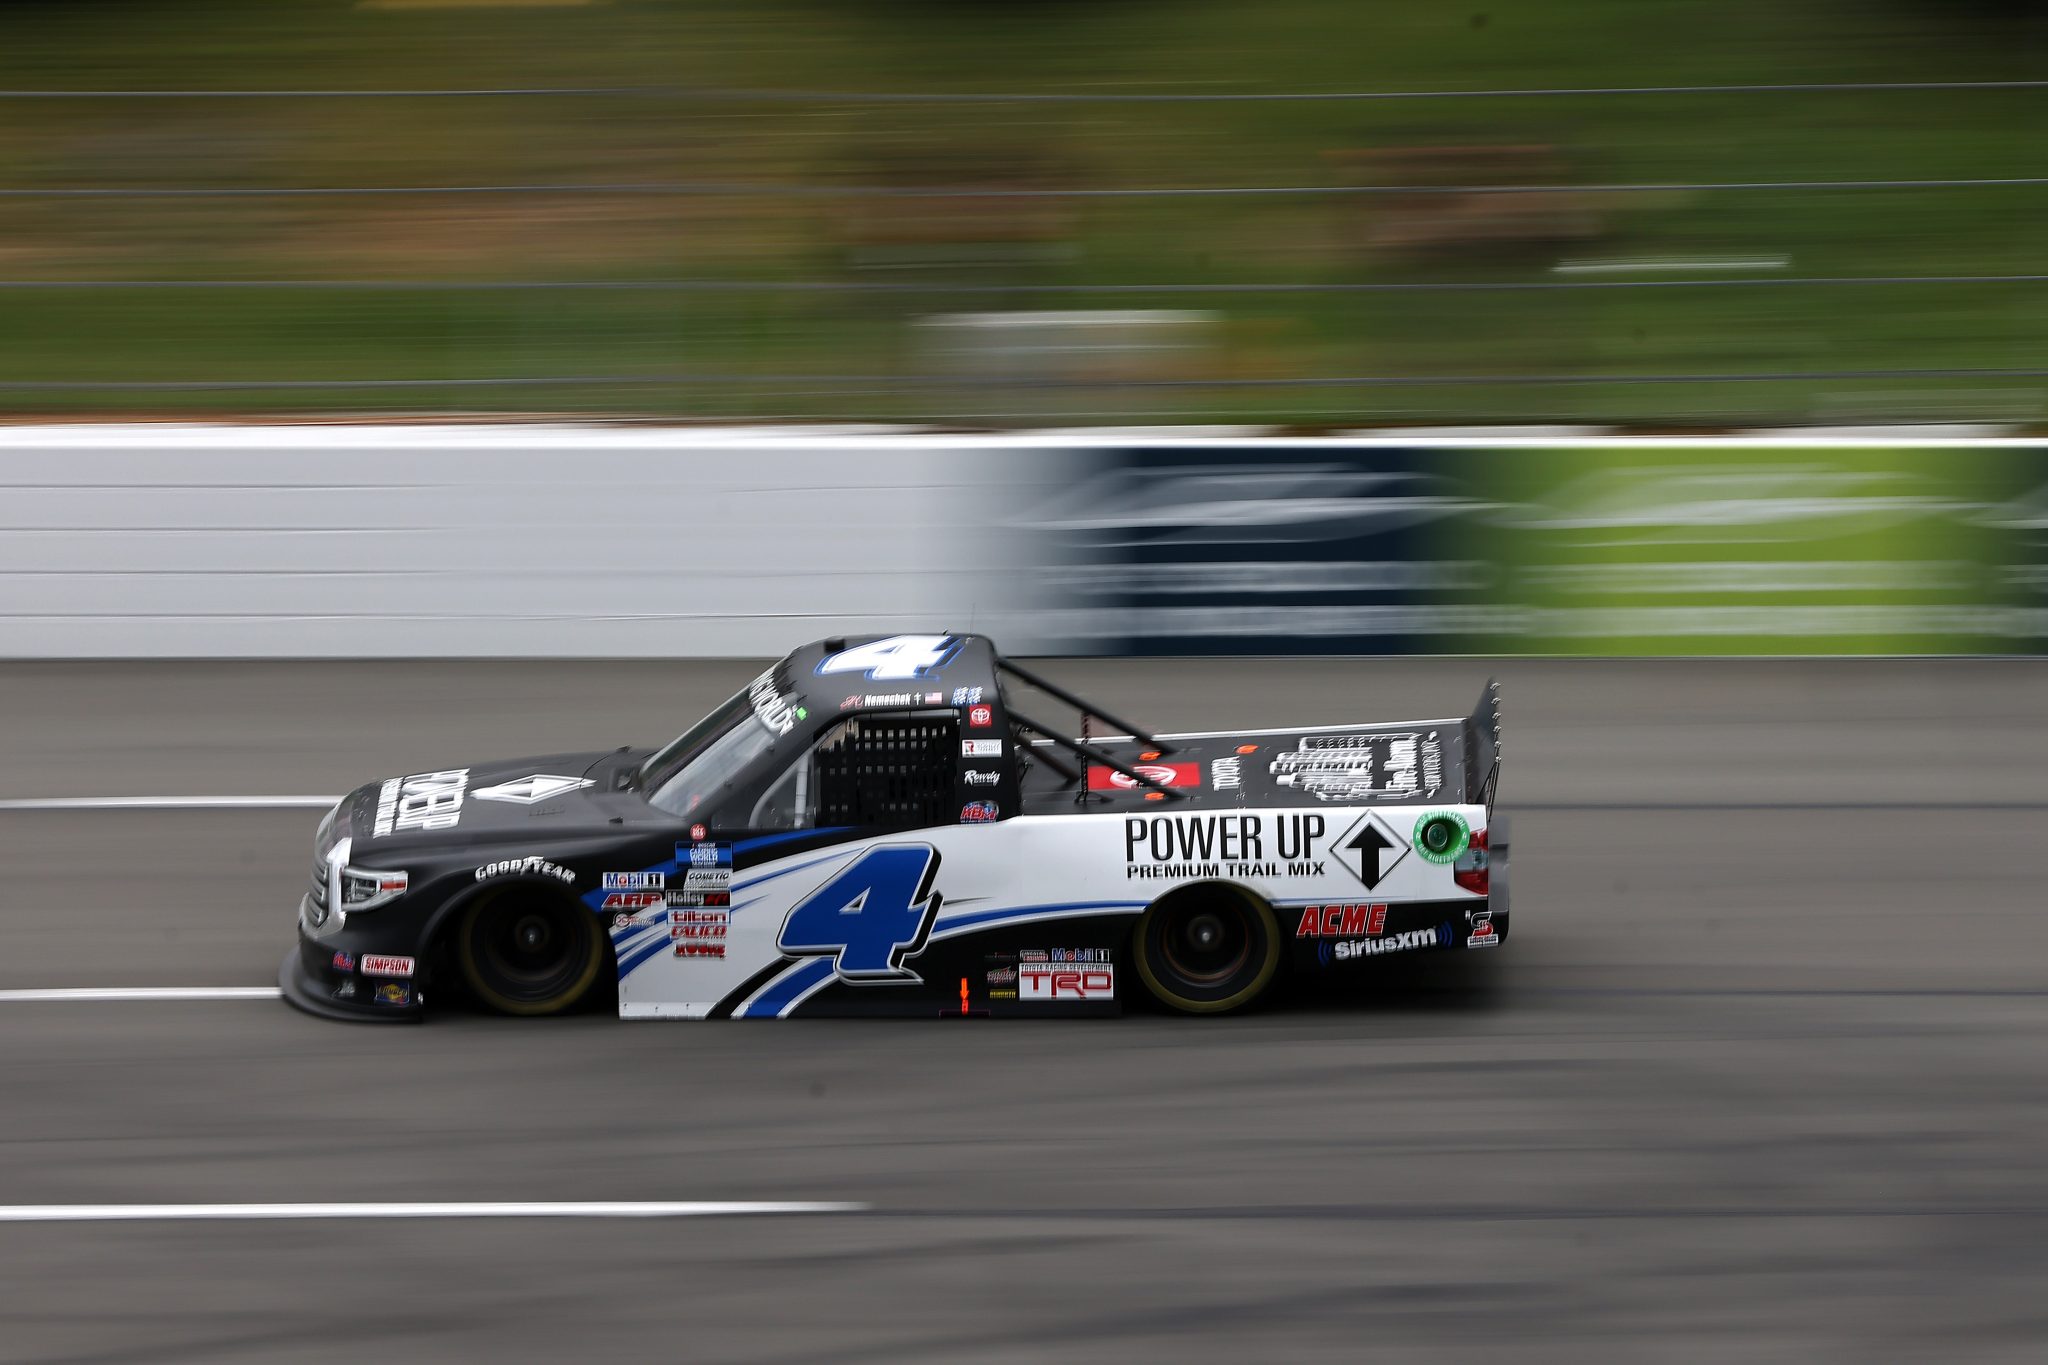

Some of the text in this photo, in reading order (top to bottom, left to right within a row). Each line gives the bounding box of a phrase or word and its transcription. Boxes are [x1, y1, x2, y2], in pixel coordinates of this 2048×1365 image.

[814, 634, 963, 681] 4
[1125, 813, 1325, 862] POWER UP
[475, 856, 576, 884] GOODYEAR
[606, 873, 644, 887] Mobil
[1127, 861, 1325, 879] PREMIUM TRAIL MIX
[602, 893, 662, 909] ARP
[671, 911, 727, 922] tilton
[776, 841, 942, 985] 4
[1296, 903, 1388, 938] ACME
[366, 956, 409, 972] SIMPSON
[1051, 948, 1093, 963] Mobil
[1020, 971, 1112, 999] TRD
